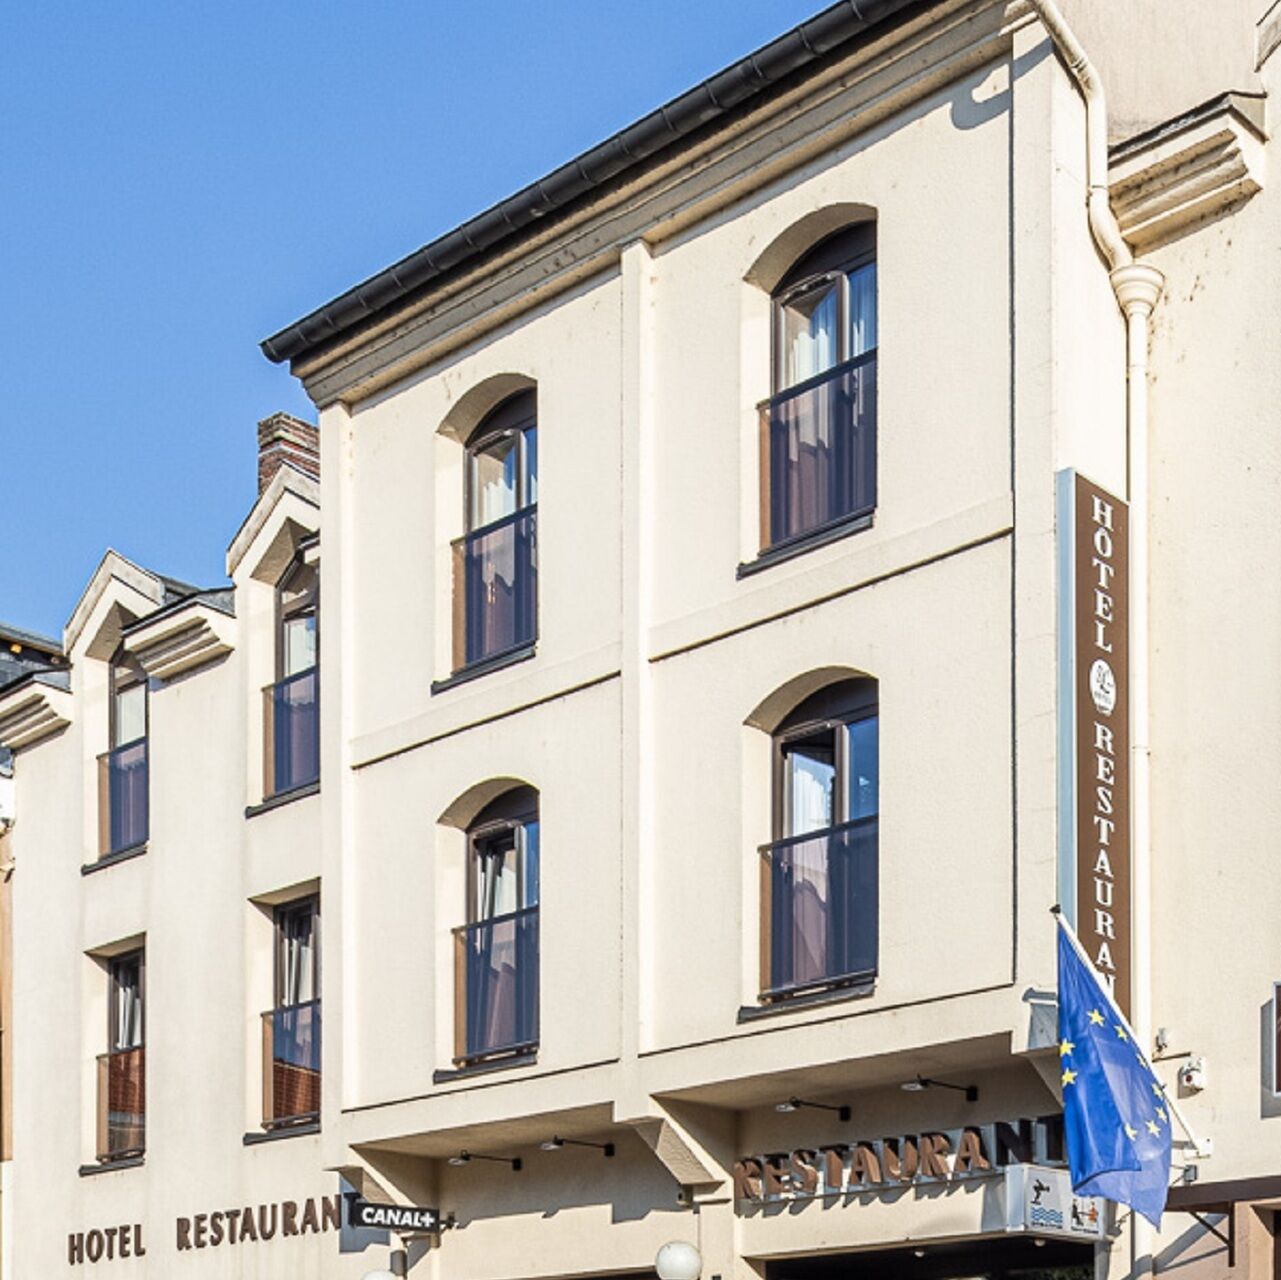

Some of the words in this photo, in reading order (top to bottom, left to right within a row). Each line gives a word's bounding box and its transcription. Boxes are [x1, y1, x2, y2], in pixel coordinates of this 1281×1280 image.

[1093, 720, 1116, 1002] RESTAURAN
[361, 1207, 436, 1227] CANAL+
[68, 1224, 146, 1265] HOTEL
